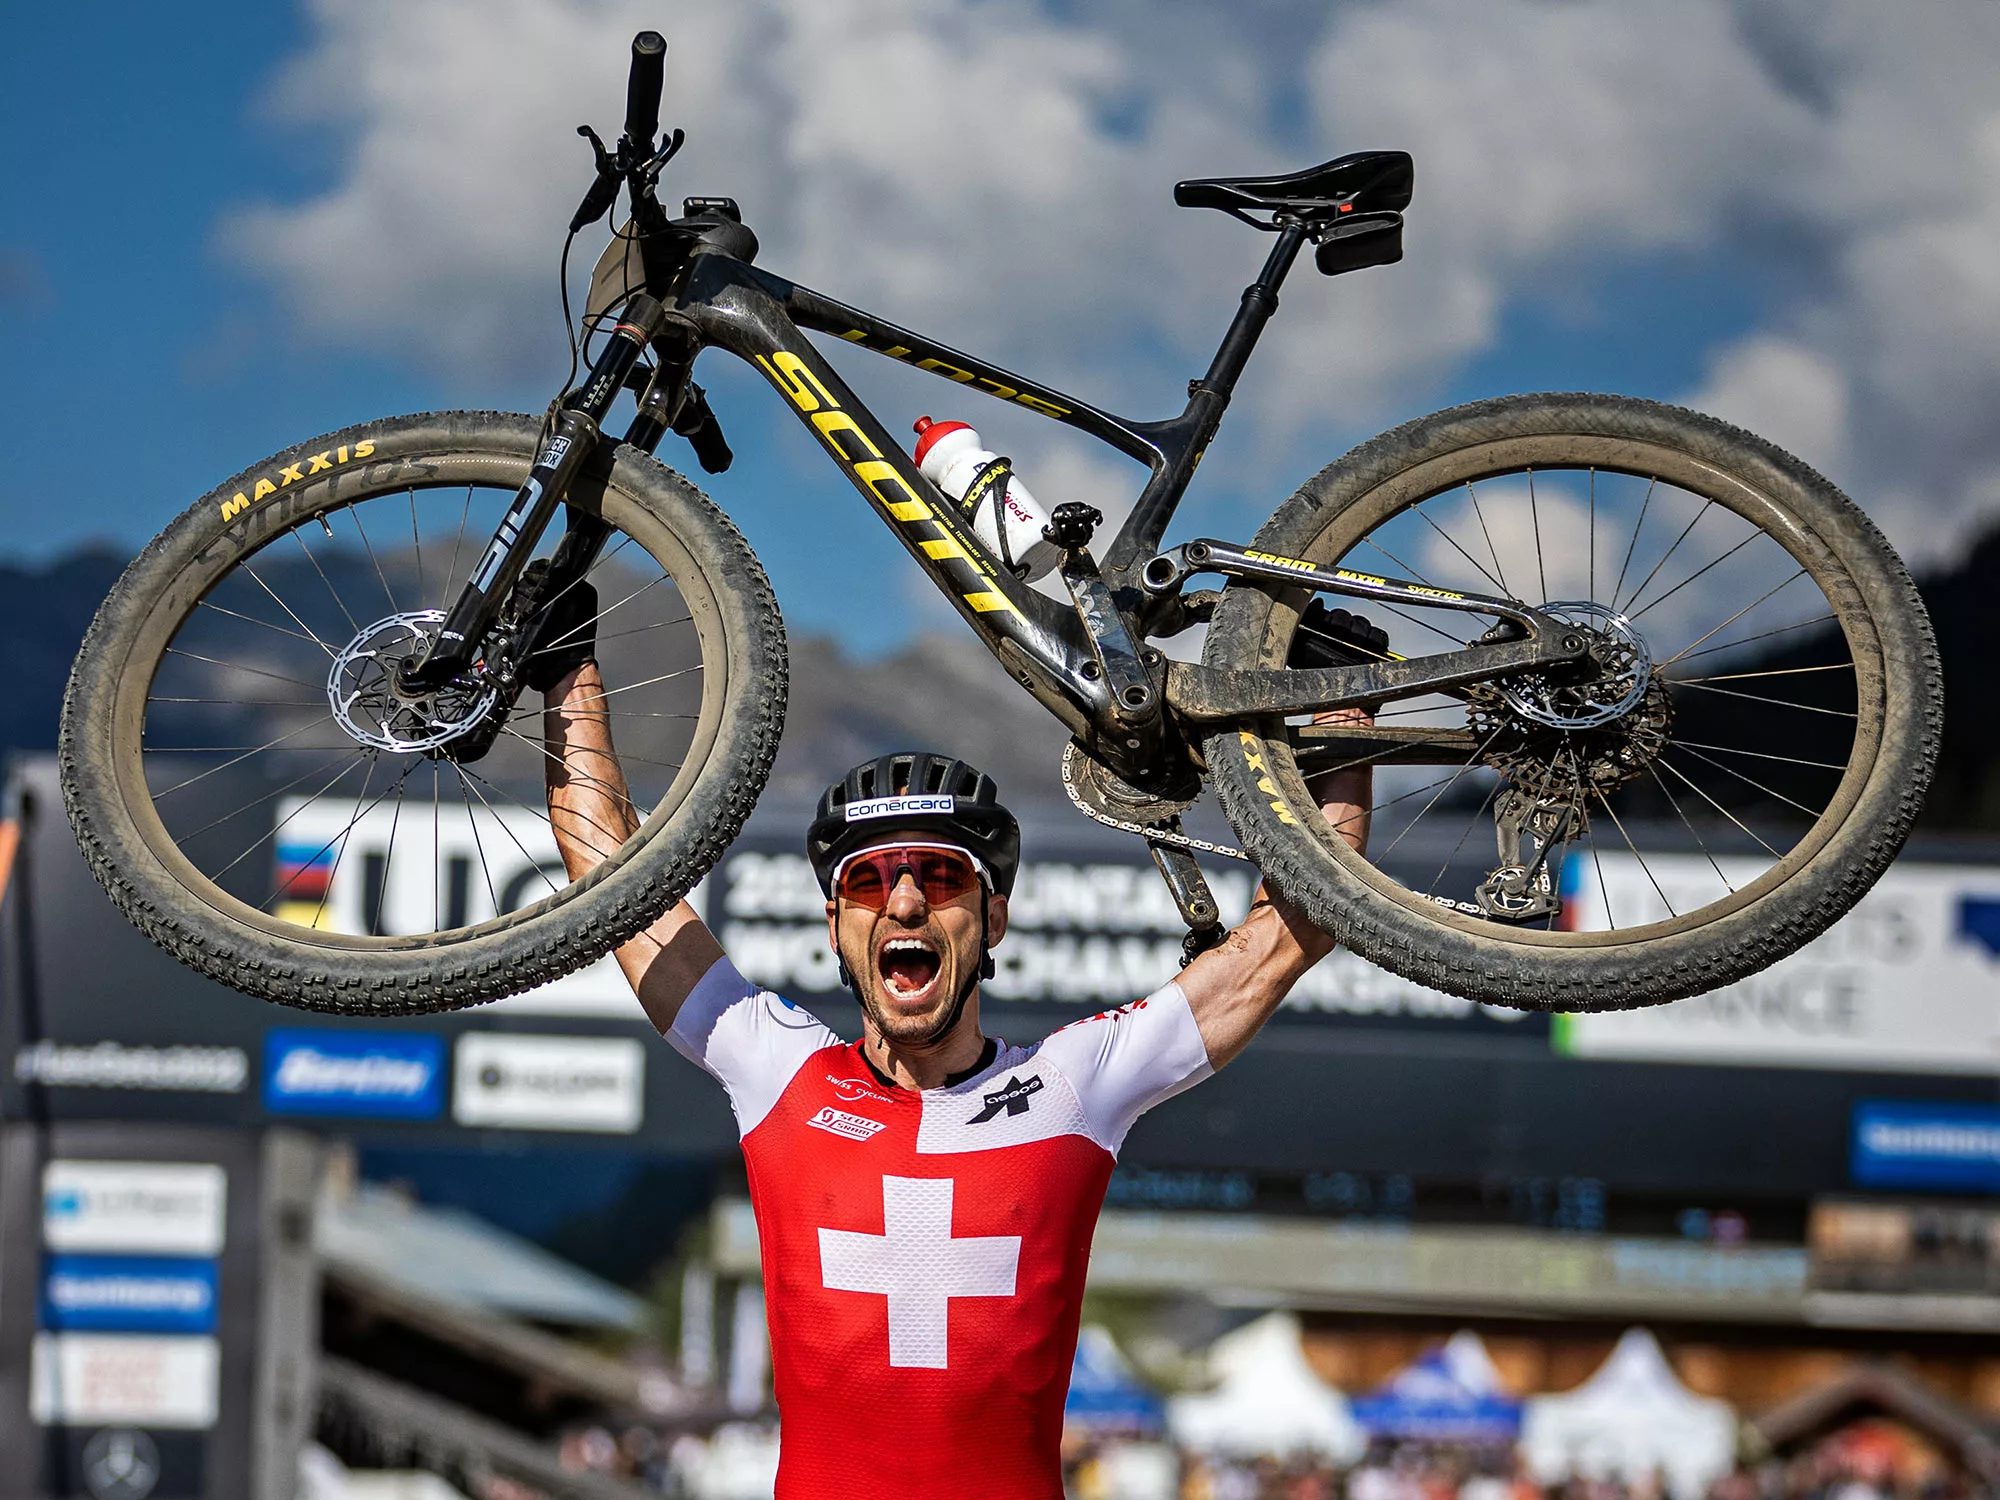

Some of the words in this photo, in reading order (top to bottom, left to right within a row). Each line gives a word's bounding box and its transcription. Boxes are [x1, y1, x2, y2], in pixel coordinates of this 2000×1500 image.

[220, 438, 377, 522] MAXXIS
[755, 351, 1031, 613] SCOTT
[962, 464, 1008, 508] TOPEAK
[955, 530, 981, 558] TECHNOLOGY
[1241, 550, 1316, 574] SRAM
[1336, 570, 1385, 588] MAXXIS
[1239, 728, 1299, 825] MAXX
[825, 1074, 852, 1090] SWISS
[986, 1080, 1040, 1104] assos
[836, 1122, 871, 1136] SRAM
[838, 1113, 882, 1129] SCOTT
